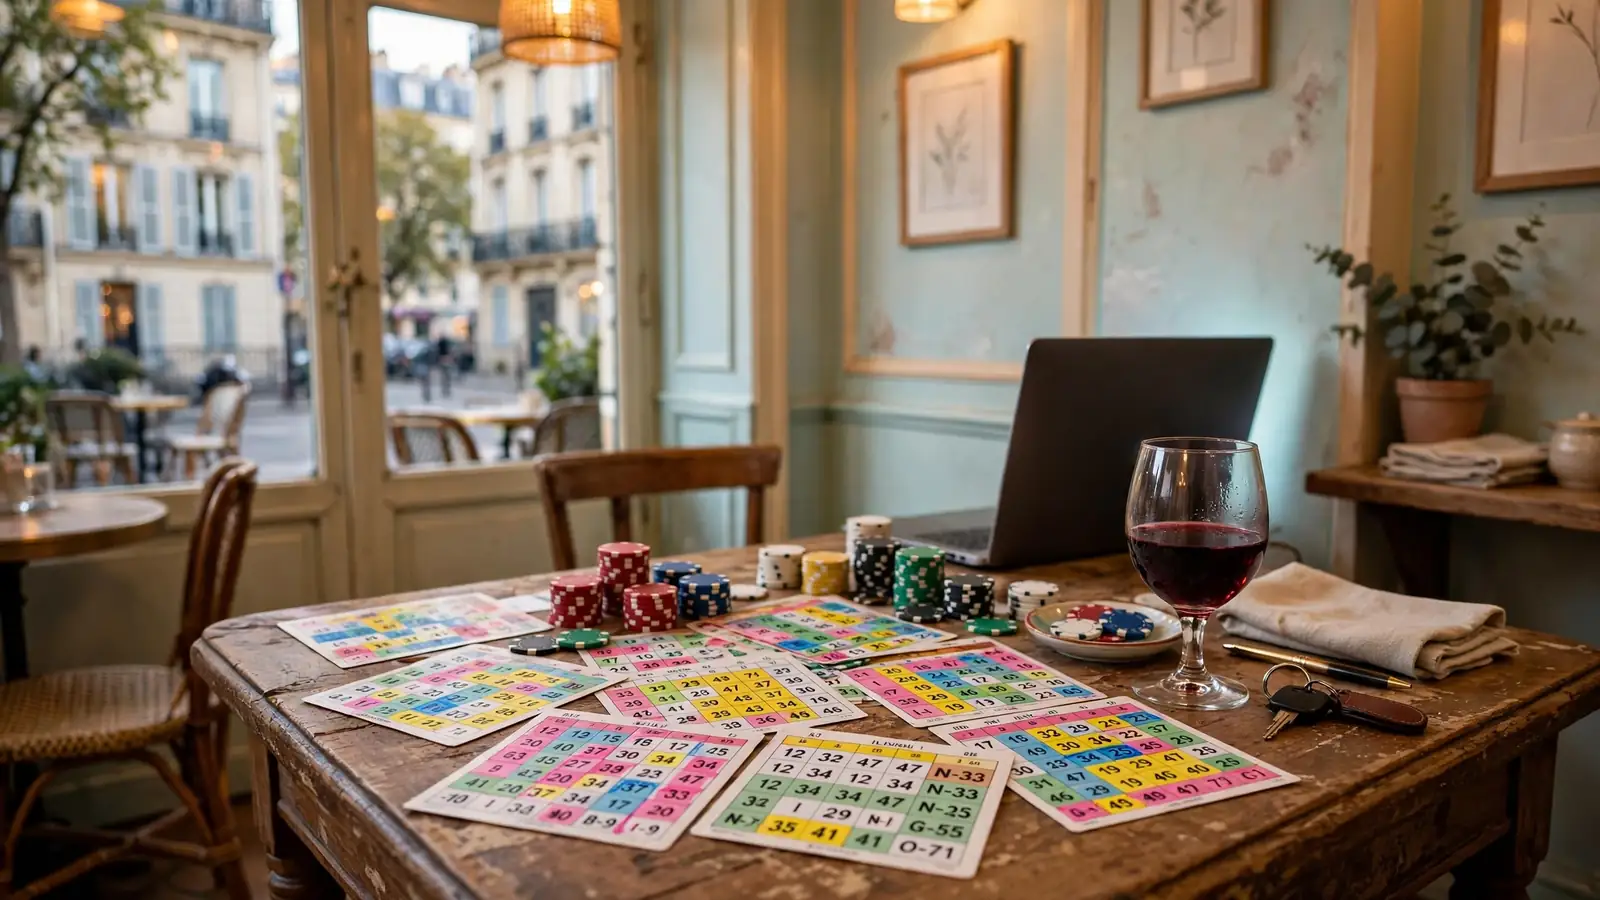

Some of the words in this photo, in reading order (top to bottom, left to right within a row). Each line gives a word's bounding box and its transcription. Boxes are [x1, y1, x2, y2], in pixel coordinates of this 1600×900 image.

[945, 703, 964, 712] 19
[539, 726, 559, 735] 12
[603, 734, 622, 743] 15
[670, 742, 689, 750] 17
[974, 740, 994, 750] 17
[1056, 742, 1080, 751] 30
[1119, 730, 1143, 739] 22
[1148, 724, 1168, 733] 37
[1170, 735, 1194, 745] 29
[616, 750, 639, 760] 30
[651, 755, 676, 764] 34
[784, 748, 806, 759] 12
[818, 751, 843, 764] 32
[856, 757, 882, 769] 47
[895, 762, 923, 774] 47
[934, 767, 985, 783] N-33
[1066, 772, 1087, 782] 47
[1099, 765, 1121, 775] 19
[1129, 759, 1152, 769] 29
[1164, 752, 1184, 762] 47
[547, 774, 572, 783] 20
[582, 778, 608, 788] 34
[565, 760, 591, 769] 27
[637, 769, 663, 778] 23
[678, 775, 704, 784] 47
[772, 762, 794, 774] 12
[806, 767, 832, 779] 34
[850, 773, 871, 785] 12
[886, 778, 913, 791] 34
[926, 783, 978, 800] N-33
[563, 793, 590, 804] 34
[608, 800, 632, 810] 17
[760, 778, 782, 790] 12
[794, 783, 821, 796] 34
[835, 789, 862, 802] 34
[876, 795, 904, 808] 47
[918, 801, 972, 819] N-25
[1050, 792, 1074, 803] 46
[1120, 777, 1143, 788] 19
[768, 820, 796, 834] 35
[811, 826, 838, 840] 41
[856, 833, 882, 848] 41
[822, 807, 852, 820] 29
[909, 820, 964, 839] G-55
